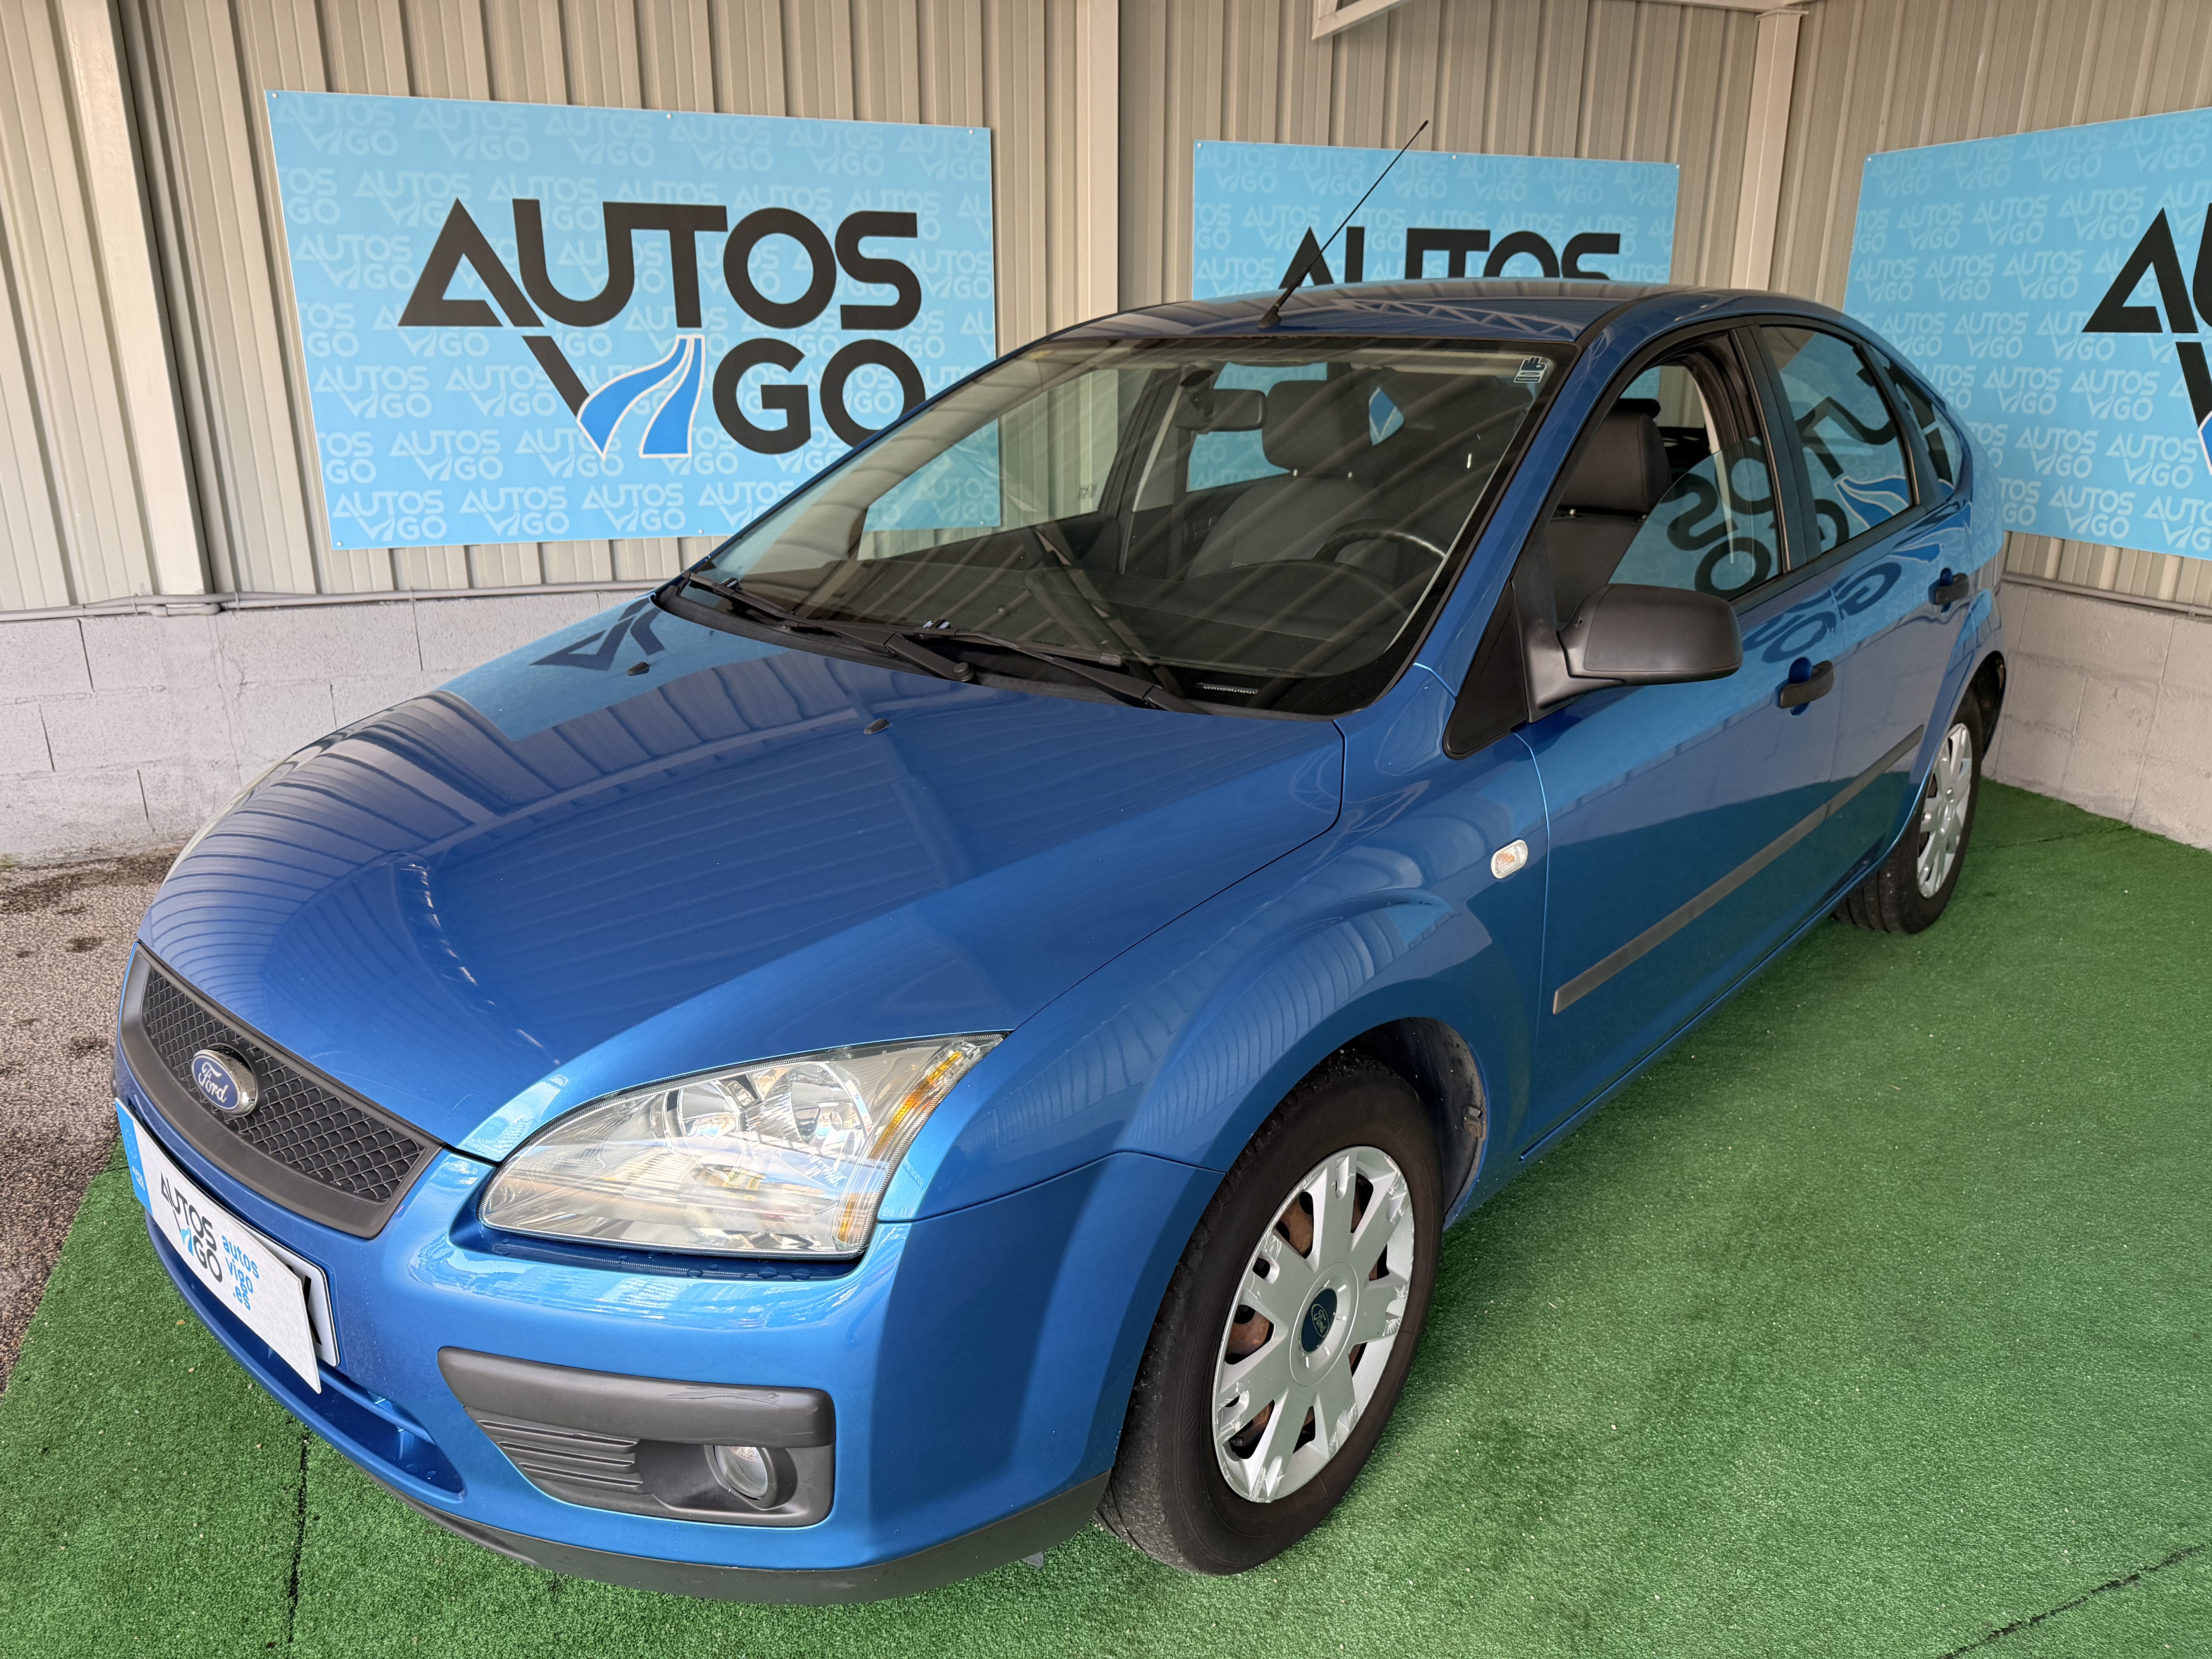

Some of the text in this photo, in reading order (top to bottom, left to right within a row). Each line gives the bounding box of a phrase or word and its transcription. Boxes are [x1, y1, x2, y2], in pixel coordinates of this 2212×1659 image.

[275, 96, 395, 128] AUTOS
[413, 102, 528, 134] AUTOS
[545, 109, 653, 139] AUTOS
[301, 123, 399, 156] VIGO
[669, 115, 771, 146] AUTOS
[786, 122, 884, 151] AUTOS
[897, 129, 989, 155] AUTOS
[2023, 125, 2109, 160] AUTOS
[439, 130, 531, 162] VIGO
[568, 136, 656, 168] VIGO
[692, 143, 773, 172] VIGO
[1940, 138, 2017, 169] AUTOS
[2133, 142, 2207, 172] VIGO
[807, 149, 885, 177] VIGO
[916, 151, 989, 181] VIGO
[2038, 154, 2102, 181] VIGO
[354, 169, 472, 200] AUTOS
[1955, 164, 2012, 191] VIGO
[1896, 202, 1965, 229] AUTOS
[1972, 195, 2050, 225] AUTOS
[2057, 185, 2147, 218] AUTOS
[1242, 205, 1321, 227] AUTOS
[2072, 213, 2141, 241] VIGO
[1908, 226, 1961, 251] VIGO
[1985, 220, 2045, 246] VIGO
[294, 234, 413, 263] AUTOS
[2002, 249, 2085, 276] AUTOS
[319, 260, 416, 290] VIGO
[398, 197, 921, 330] AUTOS
[1196, 257, 1274, 280] AUTOS
[1853, 258, 1918, 282] AUTOS
[1923, 253, 1997, 278] AUTOS
[1865, 281, 1913, 302] VIGO
[1937, 278, 1991, 302] VIGO
[2018, 275, 2079, 300] VIGO
[1879, 312, 1946, 335] AUTOS
[1953, 312, 2029, 335] AUTOS
[398, 329, 490, 357] VIGO
[1966, 335, 2024, 359] VIGO
[2052, 335, 2116, 362] VIGO
[314, 365, 429, 392] AUTOS
[1984, 366, 2063, 392] AUTOS
[2070, 369, 2160, 396] AUTOS
[340, 392, 432, 419] VIGO
[470, 391, 557, 417] VIGO
[521, 335, 926, 461] VIGO
[1997, 387, 2057, 415] VIGO
[2087, 392, 2154, 421] VIGO
[389, 429, 501, 457] AUTOS
[2015, 427, 2099, 455] AUTOS
[2106, 433, 2199, 464] AUTOS
[414, 456, 503, 481] VIGO
[539, 453, 624, 478] VIGO
[2031, 448, 2093, 479] VIGO
[2124, 457, 2193, 489] VIGO
[333, 490, 444, 517] AUTOS
[460, 486, 567, 514] AUTOS
[582, 483, 685, 509] AUTOS
[2049, 484, 2136, 515] AUTOS
[357, 516, 447, 541] VIGO
[483, 512, 570, 536] VIGO
[606, 508, 687, 532] VIGO
[2064, 508, 2130, 540] VIGO
[198, 1062, 229, 1103] Ford
[161, 1171, 217, 1252] AUTOS
[172, 1208, 222, 1283] VIGO
[222, 1235, 259, 1279] autos
[225, 1257, 253, 1295] vigo
[233, 1286, 251, 1310] .es
[1313, 1309, 1327, 1333] Ford
